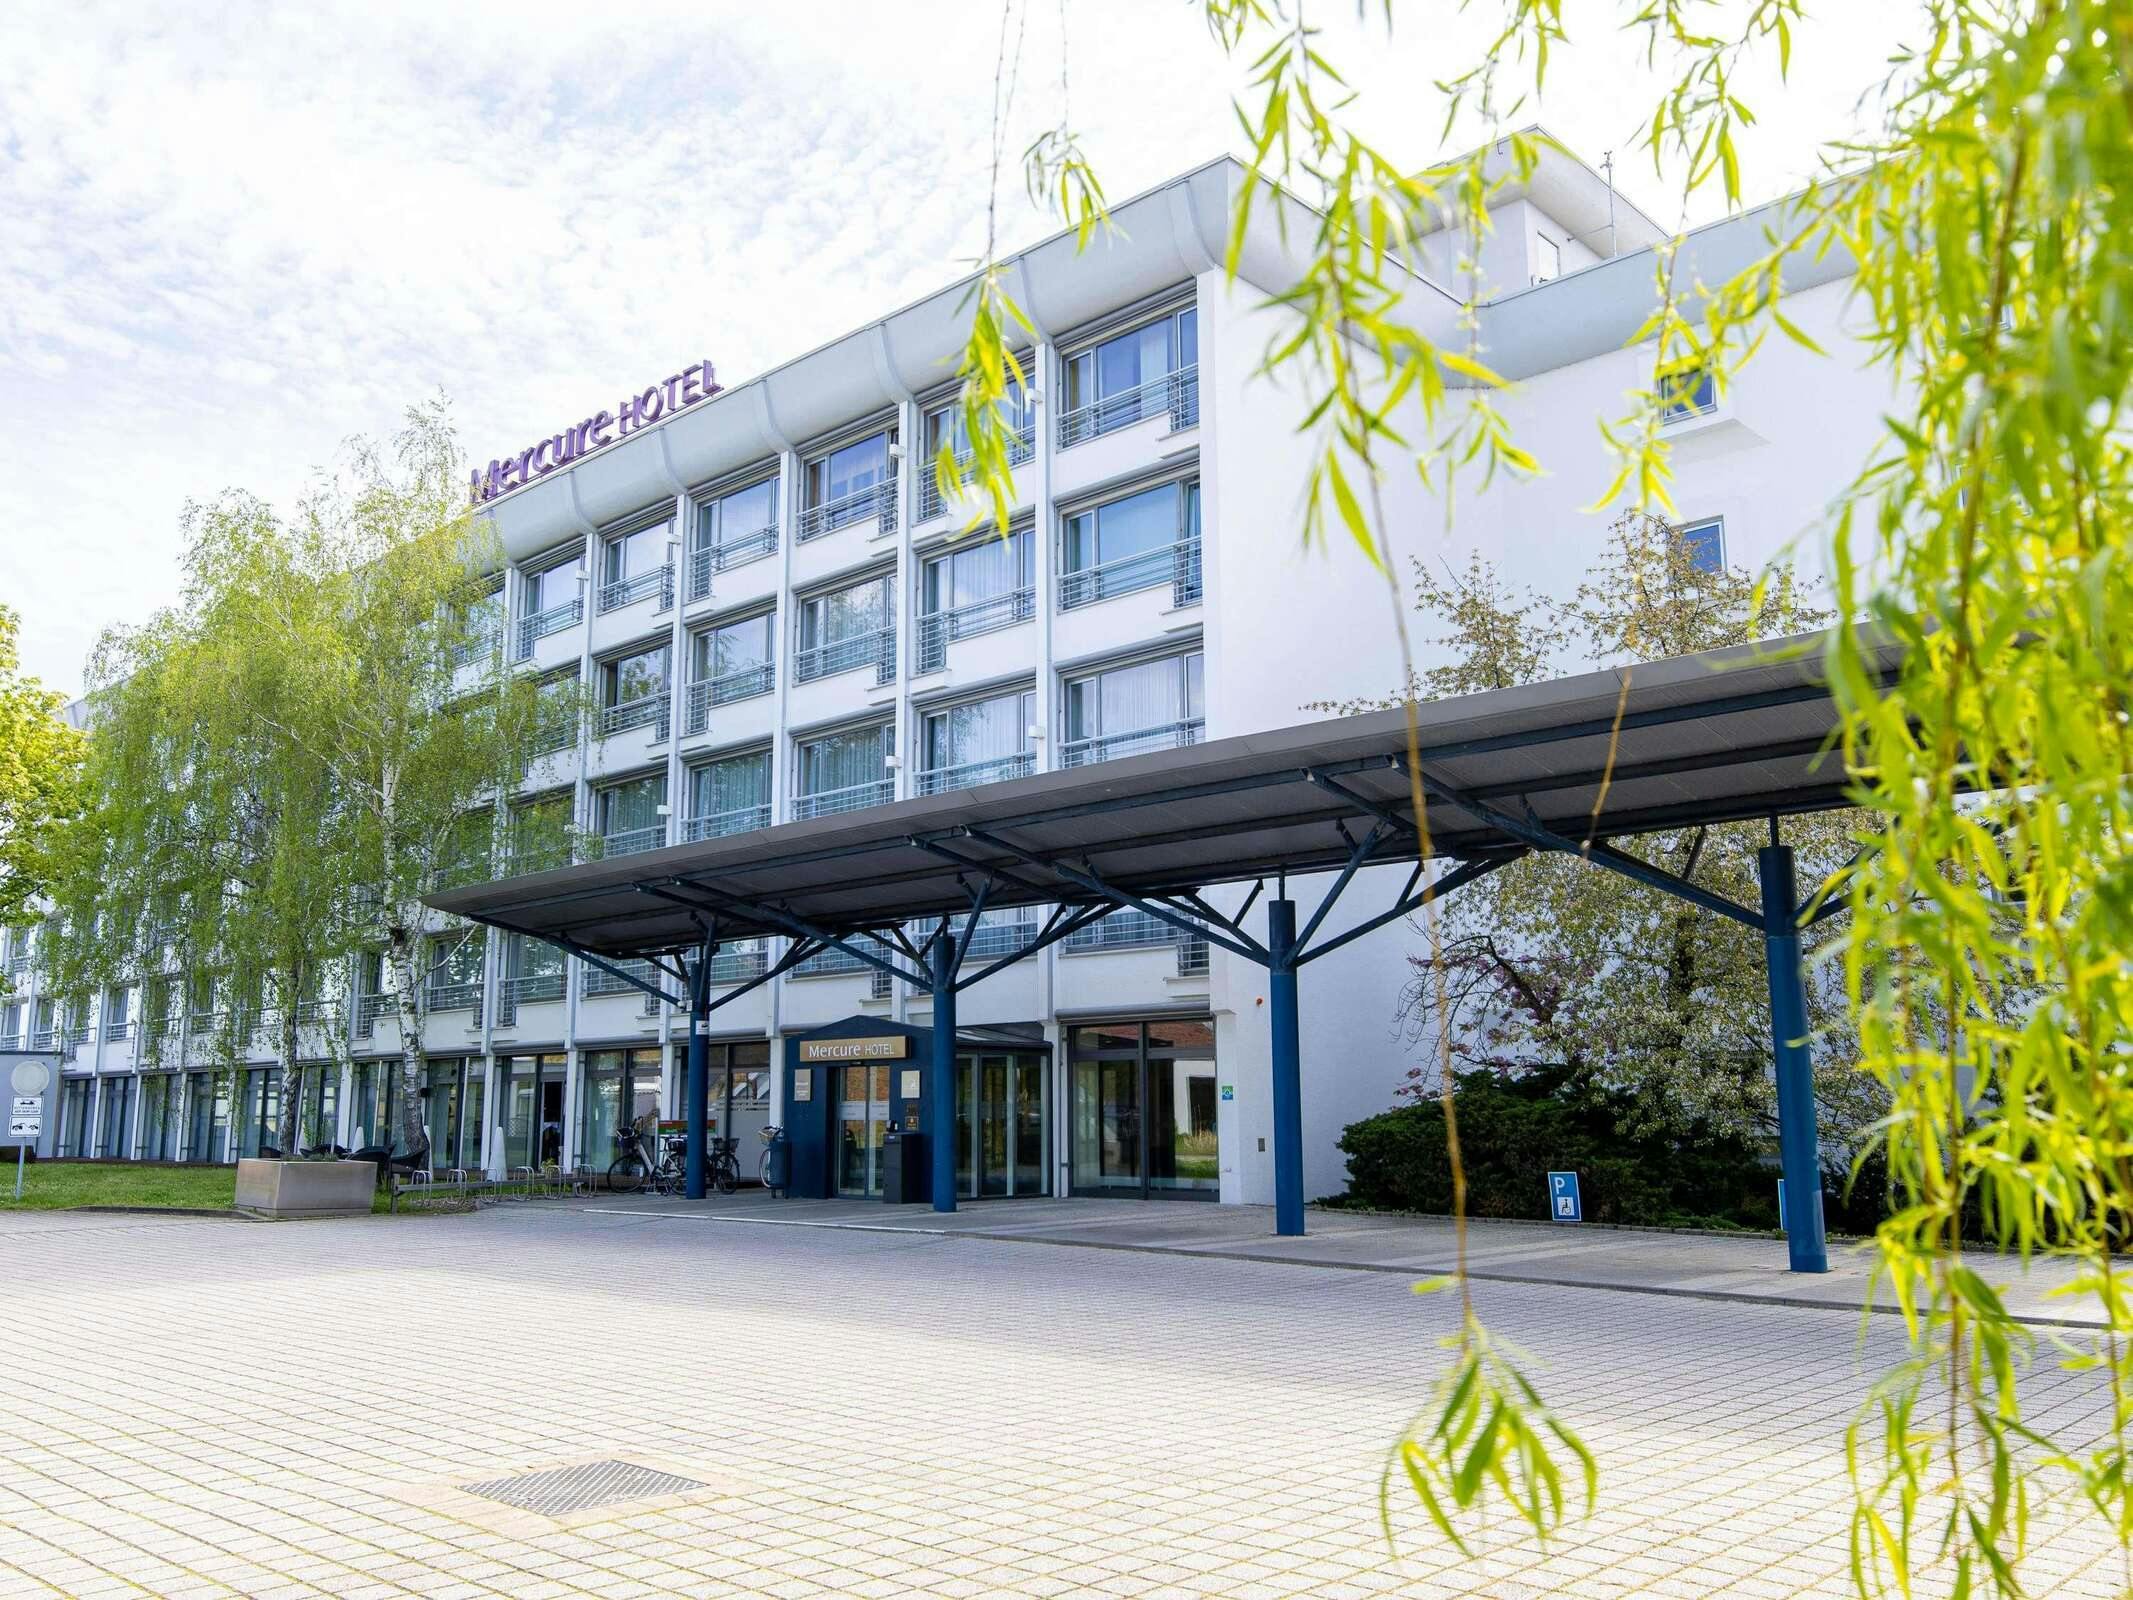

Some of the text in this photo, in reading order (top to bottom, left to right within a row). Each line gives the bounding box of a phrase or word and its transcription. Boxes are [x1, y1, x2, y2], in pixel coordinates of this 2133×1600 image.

[470, 359, 724, 503] Mercure HOTEL
[808, 1043, 895, 1058] Mercure HOTEL
[1554, 1176, 1566, 1195] P
